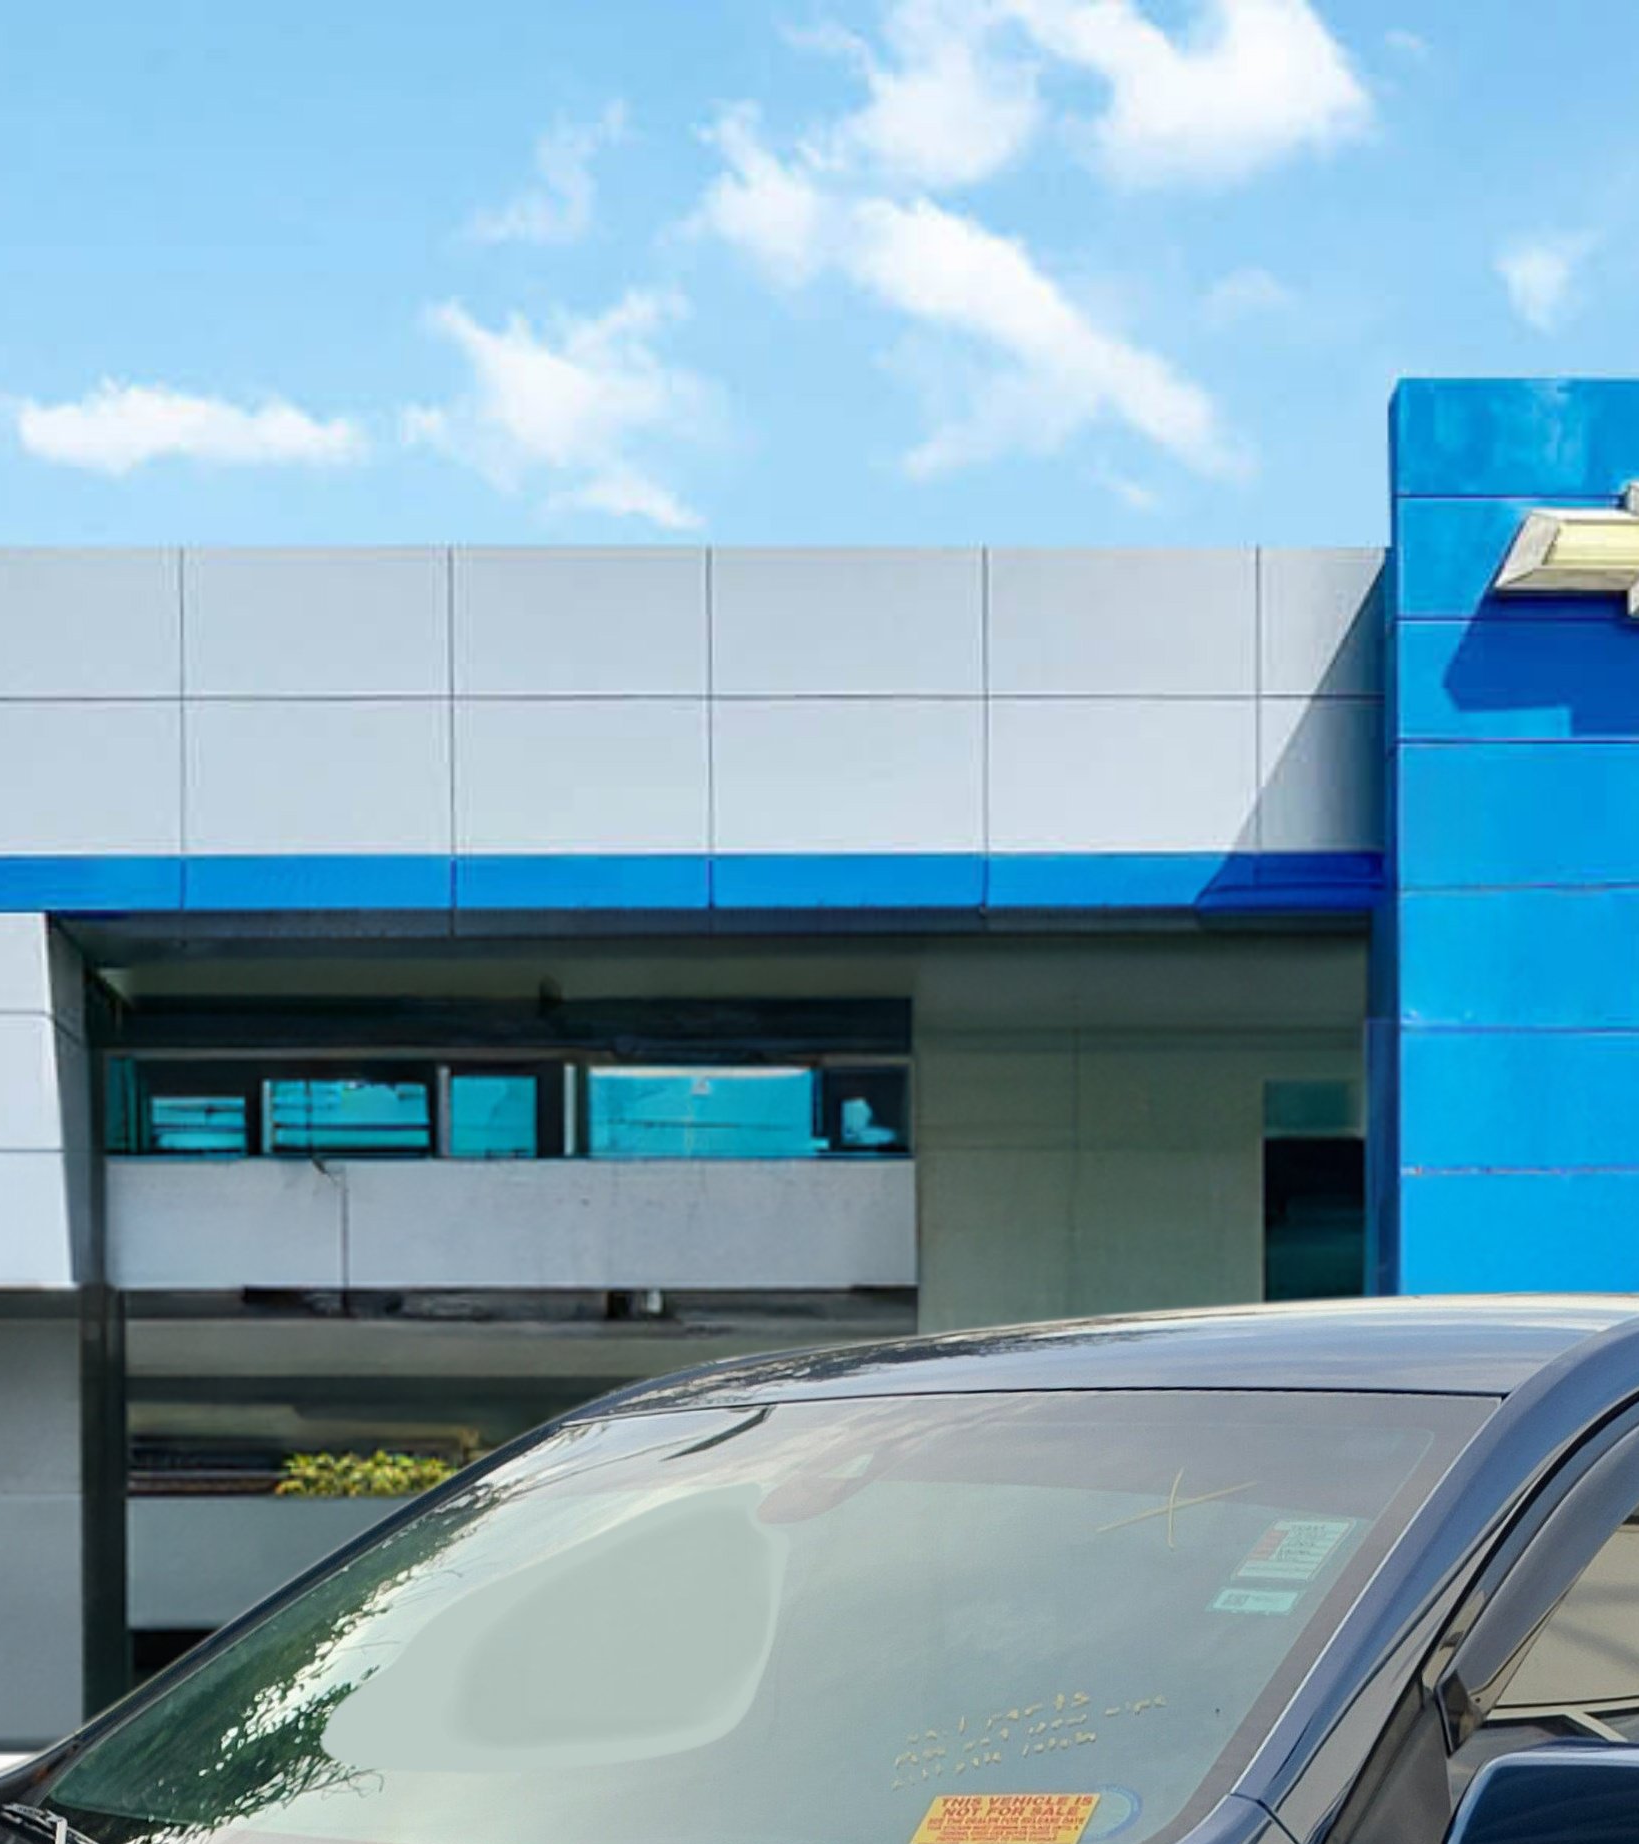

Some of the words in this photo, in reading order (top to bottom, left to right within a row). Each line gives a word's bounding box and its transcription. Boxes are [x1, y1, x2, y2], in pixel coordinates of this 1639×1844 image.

[941, 1796, 982, 1807] THIS
[987, 1795, 1068, 1807] VEHICLE
[1075, 1795, 1094, 1806] IS
[943, 1807, 983, 1817] NOT
[986, 1807, 1026, 1817] FOR
[1031, 1806, 1079, 1816] SALE
